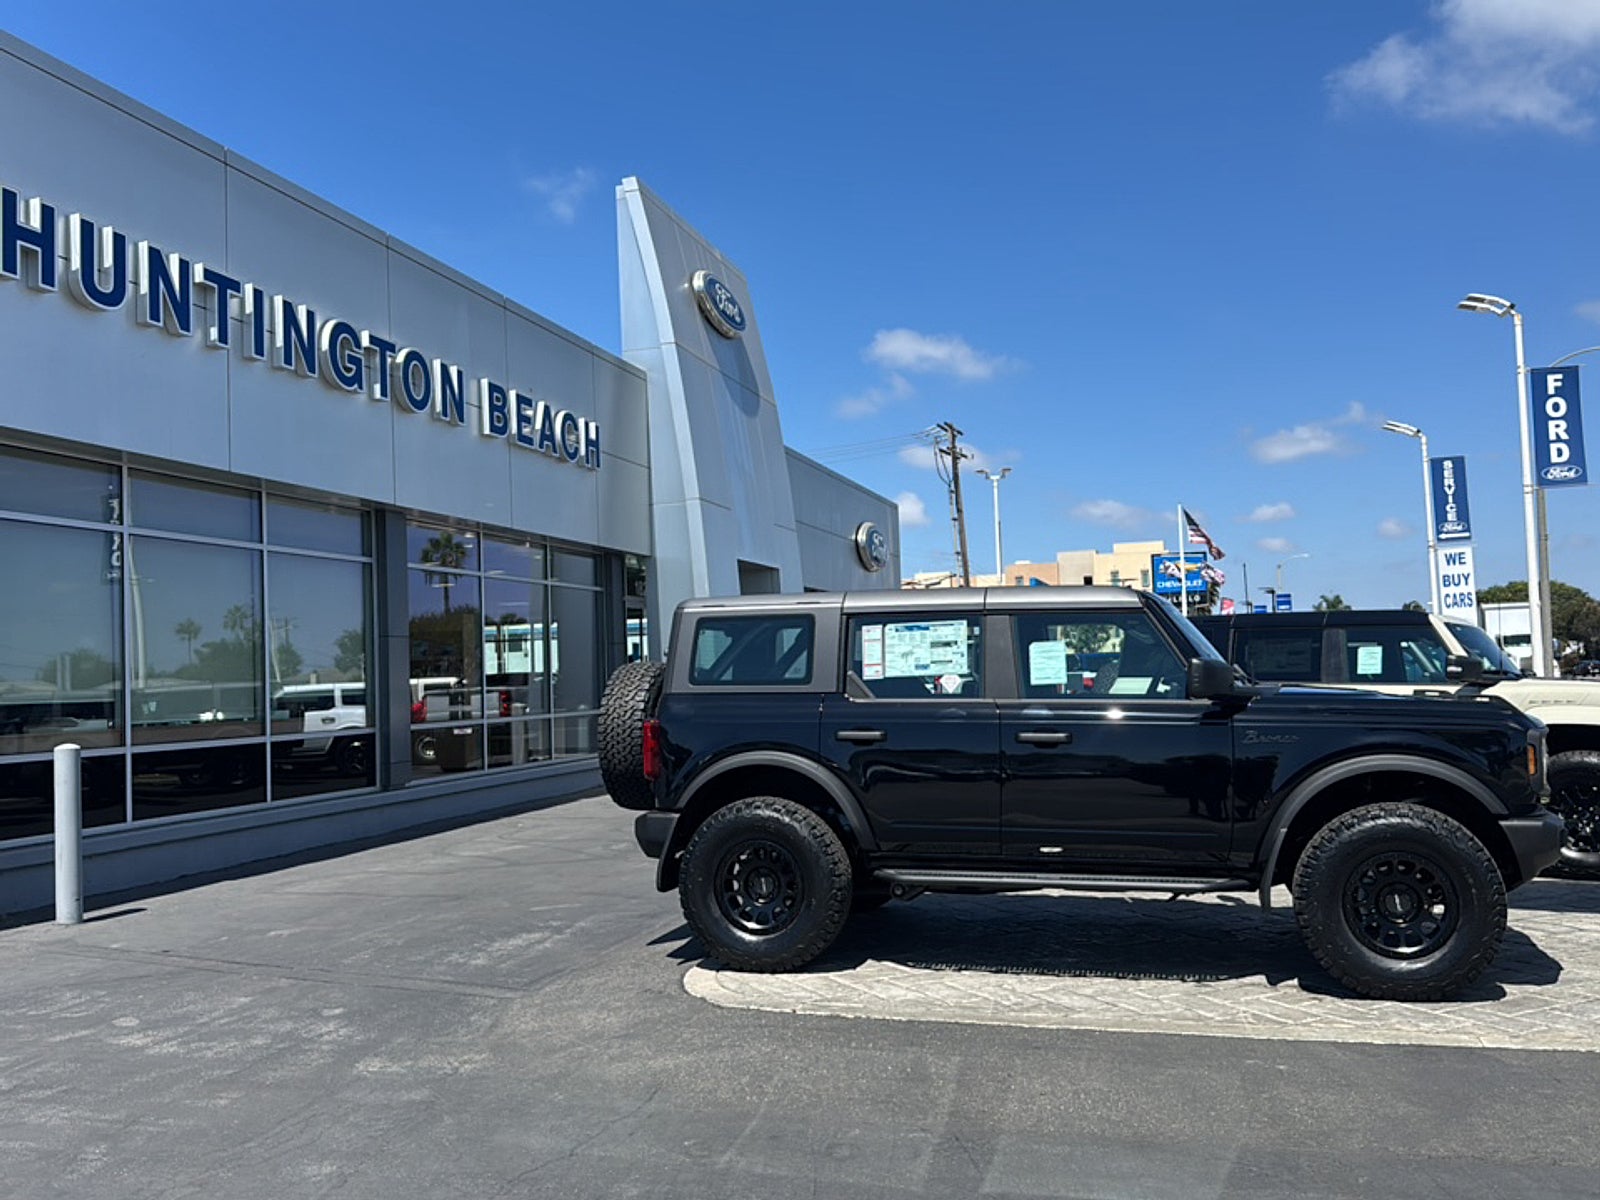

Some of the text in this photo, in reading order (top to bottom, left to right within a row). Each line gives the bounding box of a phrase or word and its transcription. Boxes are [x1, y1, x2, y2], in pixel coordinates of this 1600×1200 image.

[0, 186, 602, 470] HUNTINGTON BEACH
[1545, 373, 1571, 464] FORD
[1544, 465, 1581, 480] Ford
[1442, 460, 1458, 521] SERVICE
[1444, 552, 1467, 566] WE
[1442, 573, 1470, 587] BUY
[1444, 592, 1473, 609] CARS
